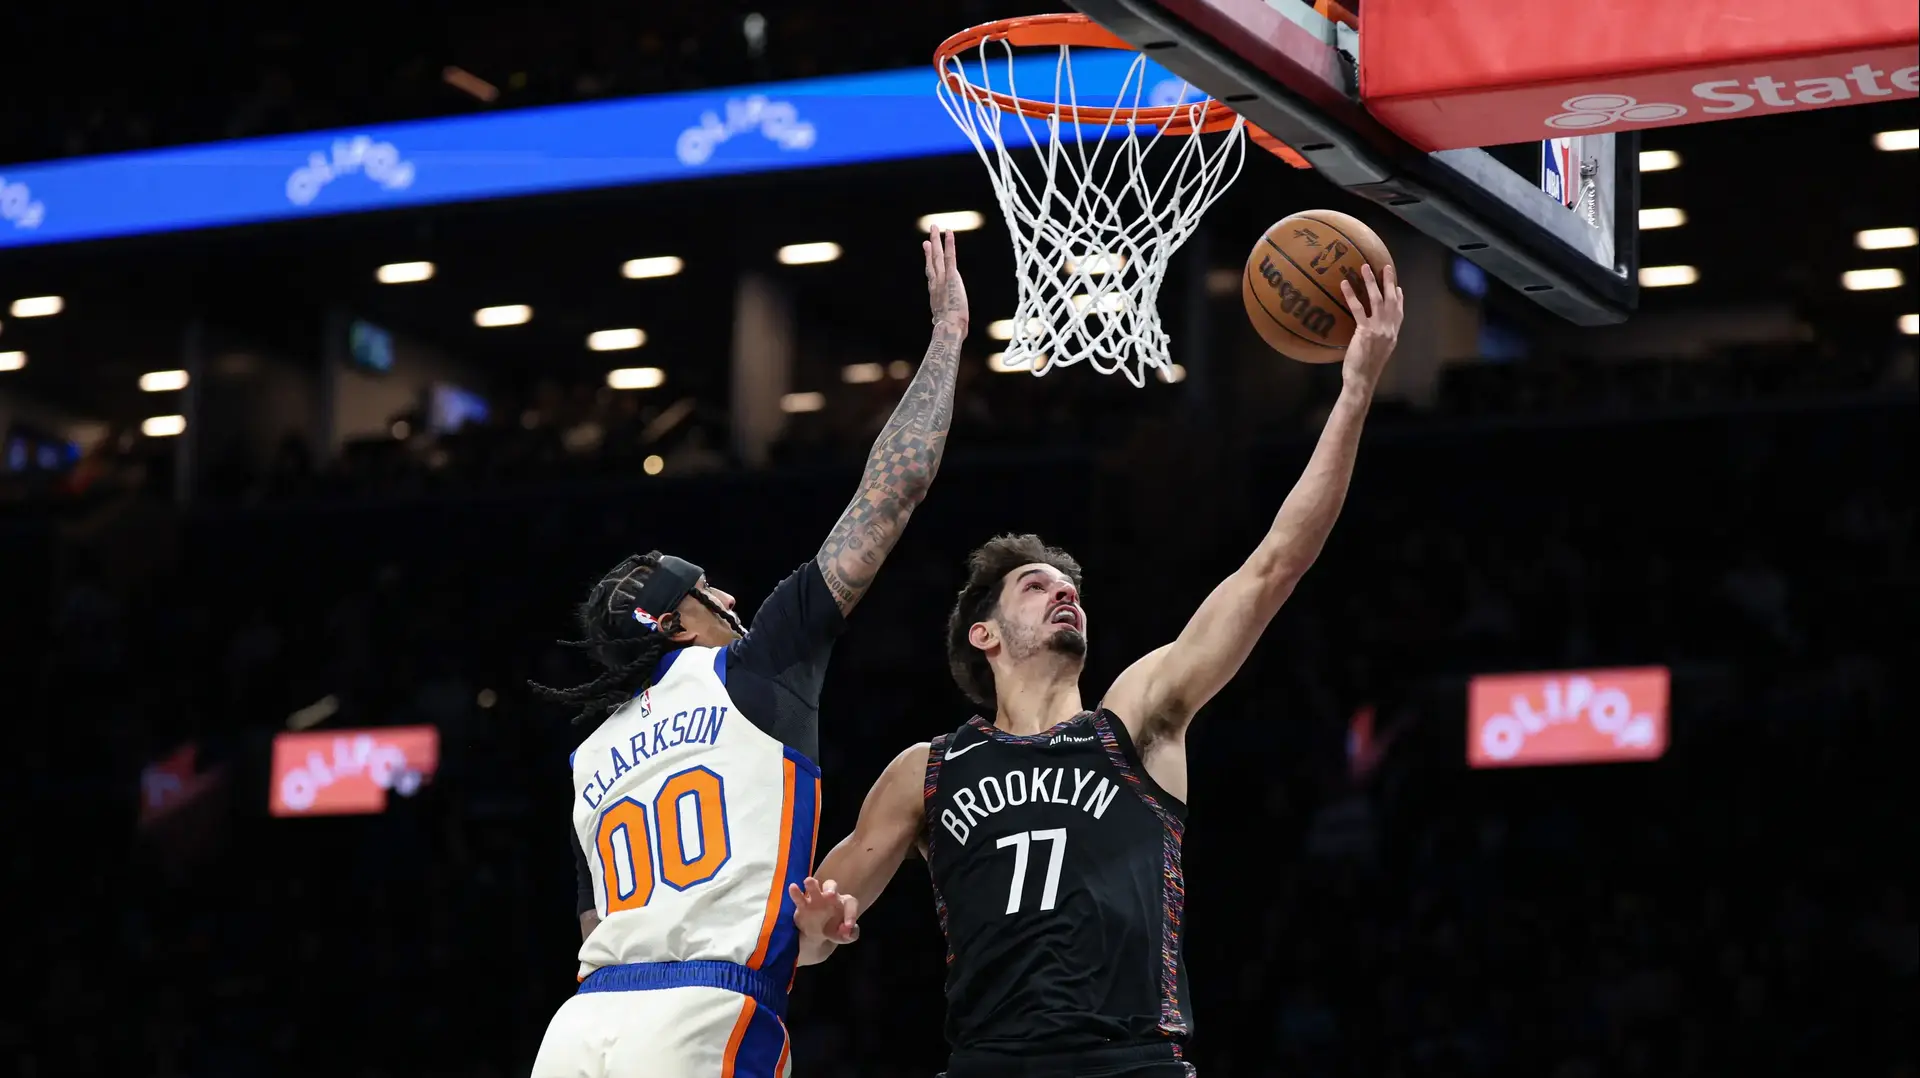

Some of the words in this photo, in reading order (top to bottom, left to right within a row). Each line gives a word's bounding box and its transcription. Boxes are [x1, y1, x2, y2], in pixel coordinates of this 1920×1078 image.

[1691, 64, 1919, 114] State
[1259, 254, 1336, 339] Wilson
[582, 706, 727, 810] CLARKSON
[1050, 735, 1061, 746] All
[595, 765, 732, 917] 00
[941, 767, 1119, 846] BROOKLYN
[996, 827, 1067, 915] 77
